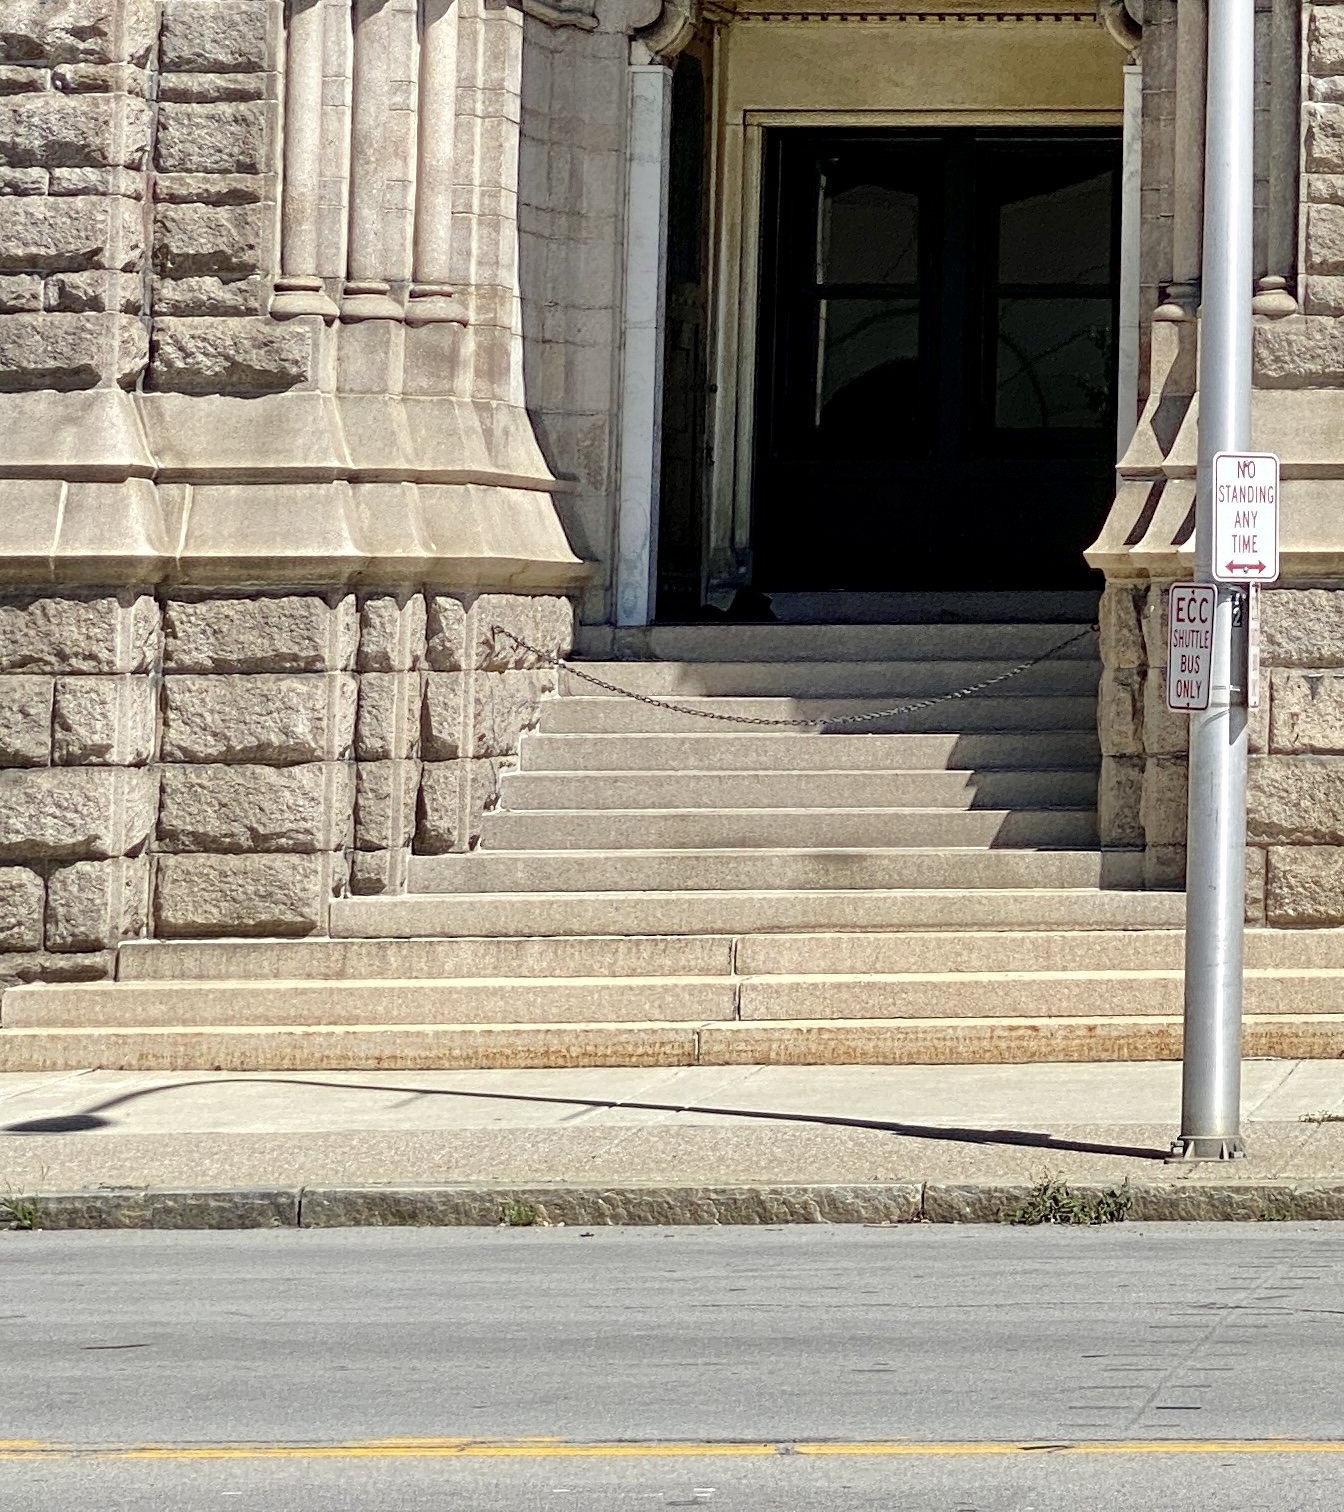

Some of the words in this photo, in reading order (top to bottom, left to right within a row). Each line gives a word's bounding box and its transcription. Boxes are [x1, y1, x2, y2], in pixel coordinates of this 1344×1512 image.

[1237, 460, 1256, 479] NO
[1218, 484, 1274, 504] STANDING
[1234, 510, 1258, 529] ANY
[1231, 534, 1258, 553] TIME
[1175, 597, 1209, 624] ECC
[1173, 629, 1209, 649] SHUTTLE
[1180, 654, 1201, 674] BUS
[1176, 679, 1202, 699] ONLY
